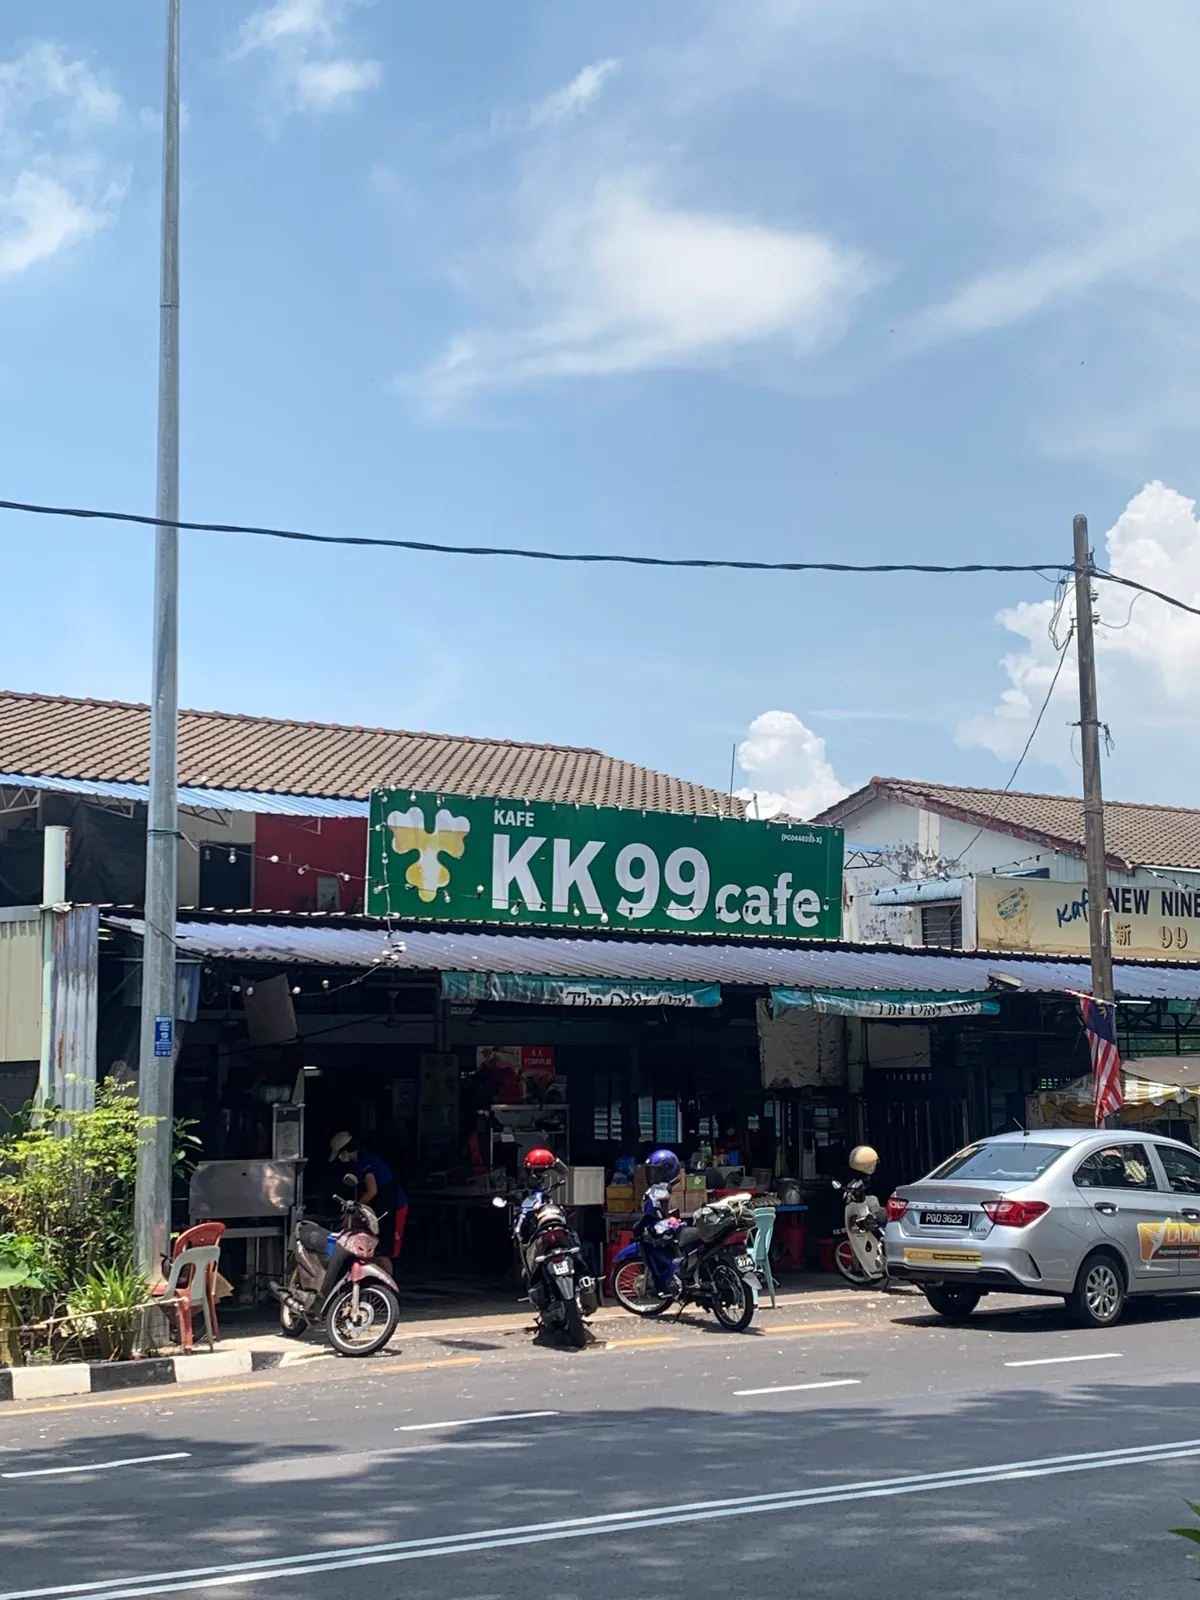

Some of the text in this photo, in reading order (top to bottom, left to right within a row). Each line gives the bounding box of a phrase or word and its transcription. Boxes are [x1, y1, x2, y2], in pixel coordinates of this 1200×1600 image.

[494, 809, 535, 828] KAFE
[491, 833, 821, 928] KK 99 cafe
[1056, 887, 1089, 928] Kaf
[1107, 887, 1150, 915] NEW
[1158, 925, 1188, 950] 99
[942, 1214, 963, 1224] 3622
